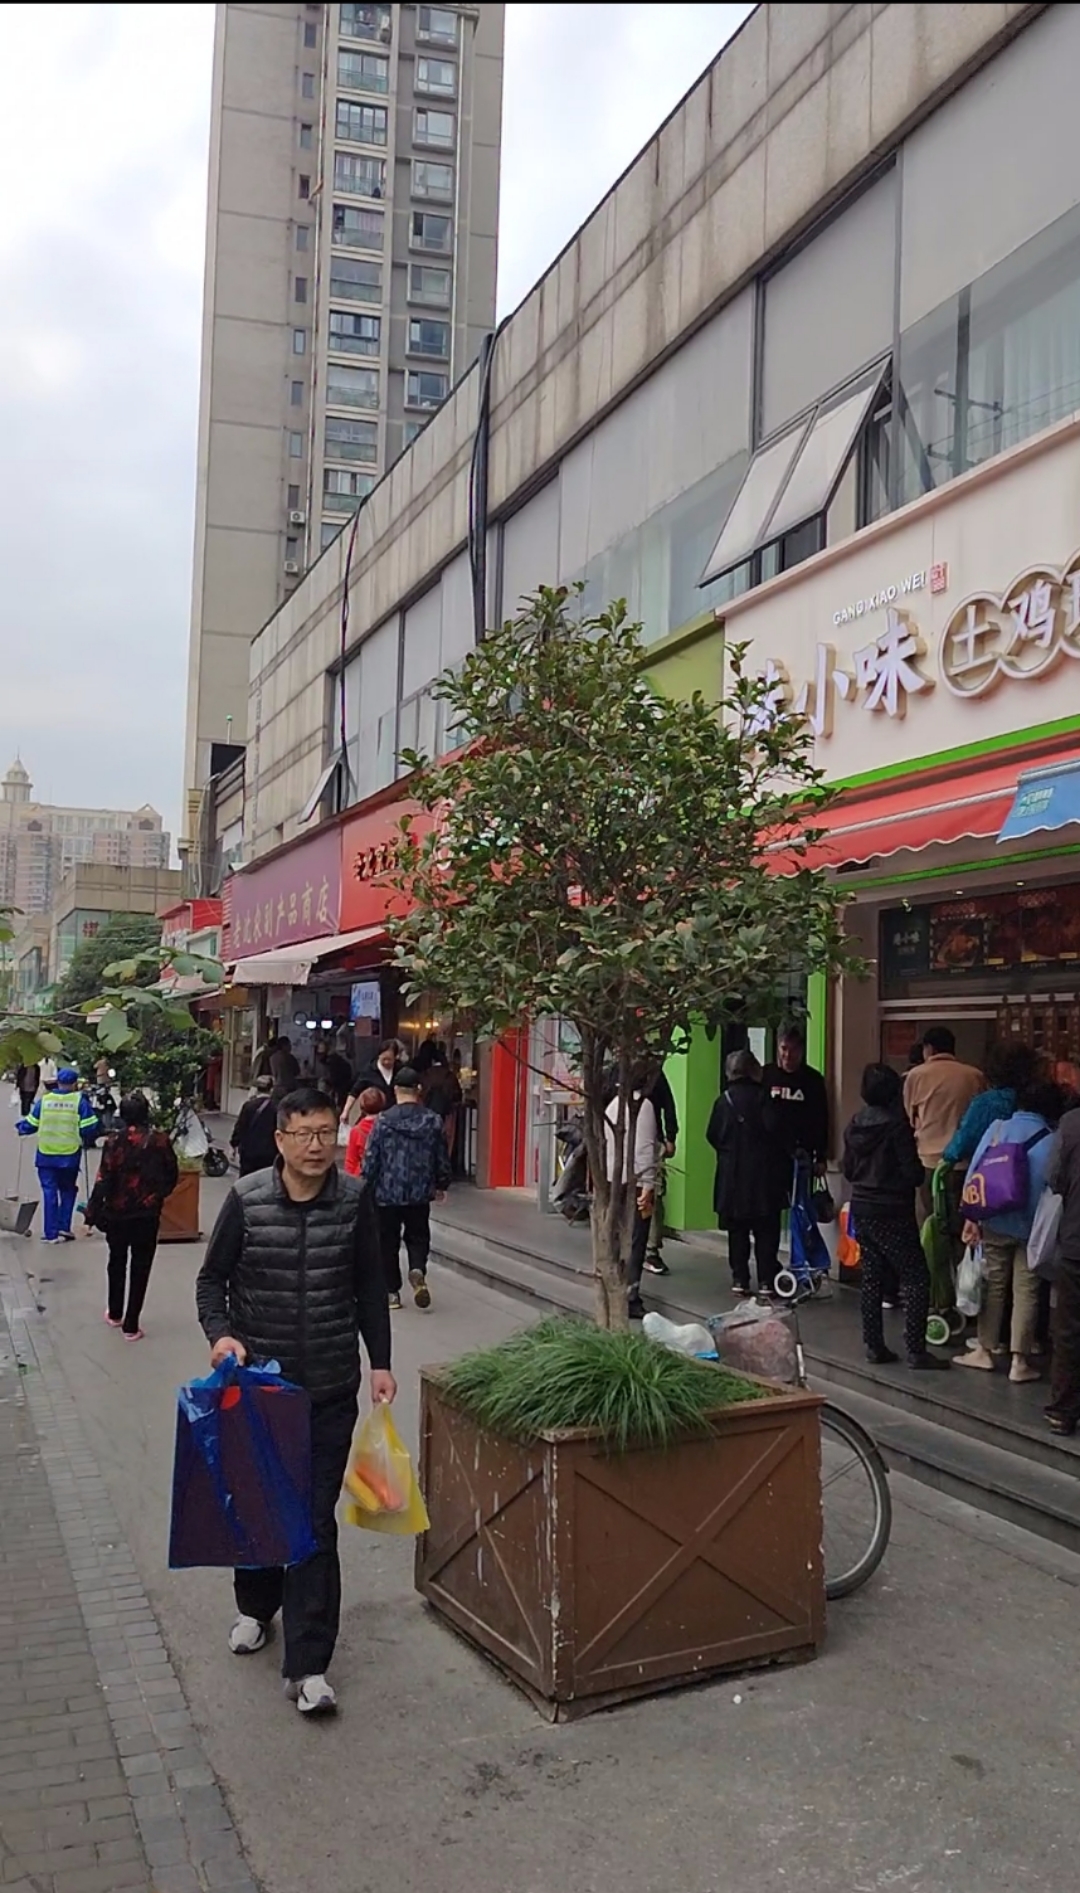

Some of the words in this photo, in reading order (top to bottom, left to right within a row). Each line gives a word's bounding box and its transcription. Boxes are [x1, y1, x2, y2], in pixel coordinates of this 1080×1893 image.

[833, 600, 866, 625] GANG
[869, 585, 898, 610] XIAO
[901, 571, 926, 593] WEI
[949, 569, 1080, 676] 土鸡
[770, 1086, 804, 1100] FILA
